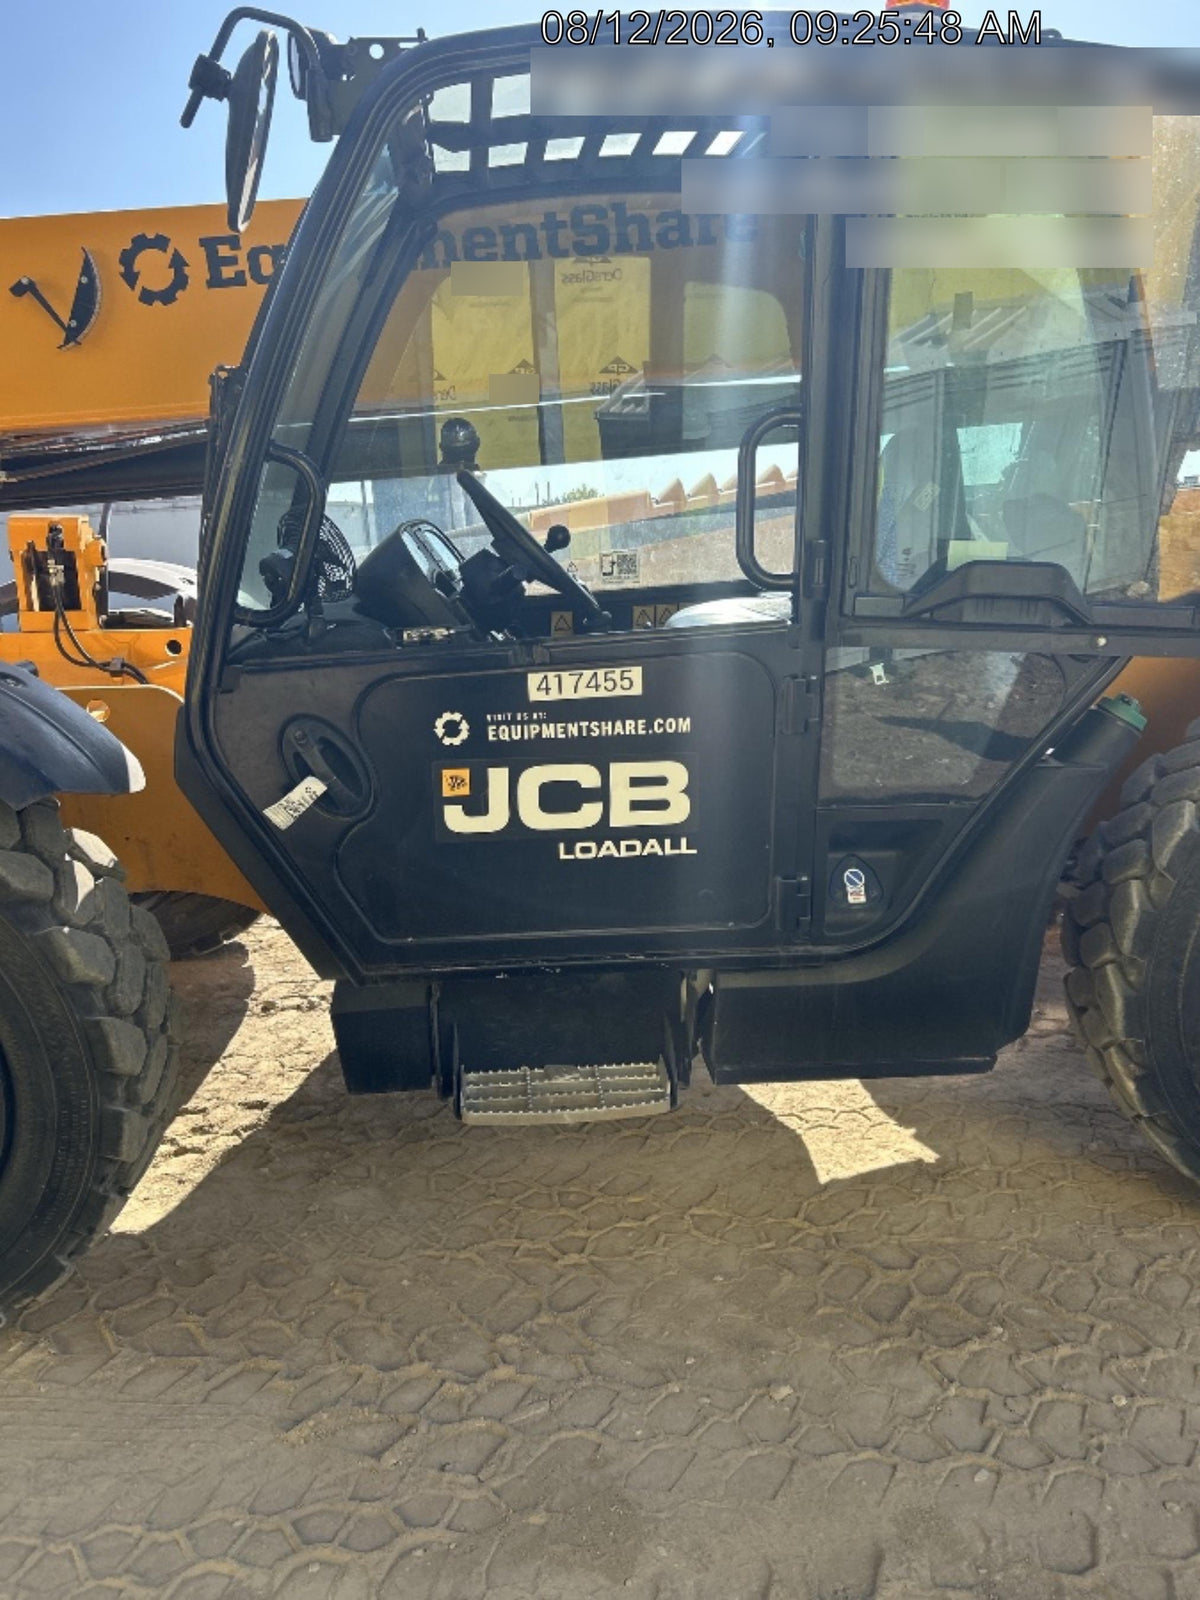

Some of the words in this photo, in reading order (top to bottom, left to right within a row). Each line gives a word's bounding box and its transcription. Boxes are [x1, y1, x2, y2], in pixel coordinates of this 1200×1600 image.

[536, 669, 635, 696] 417455
[487, 717, 691, 742] EQUIPMENTSHARE.COM
[442, 760, 692, 834] JCB
[559, 837, 698, 861] LOADALL
